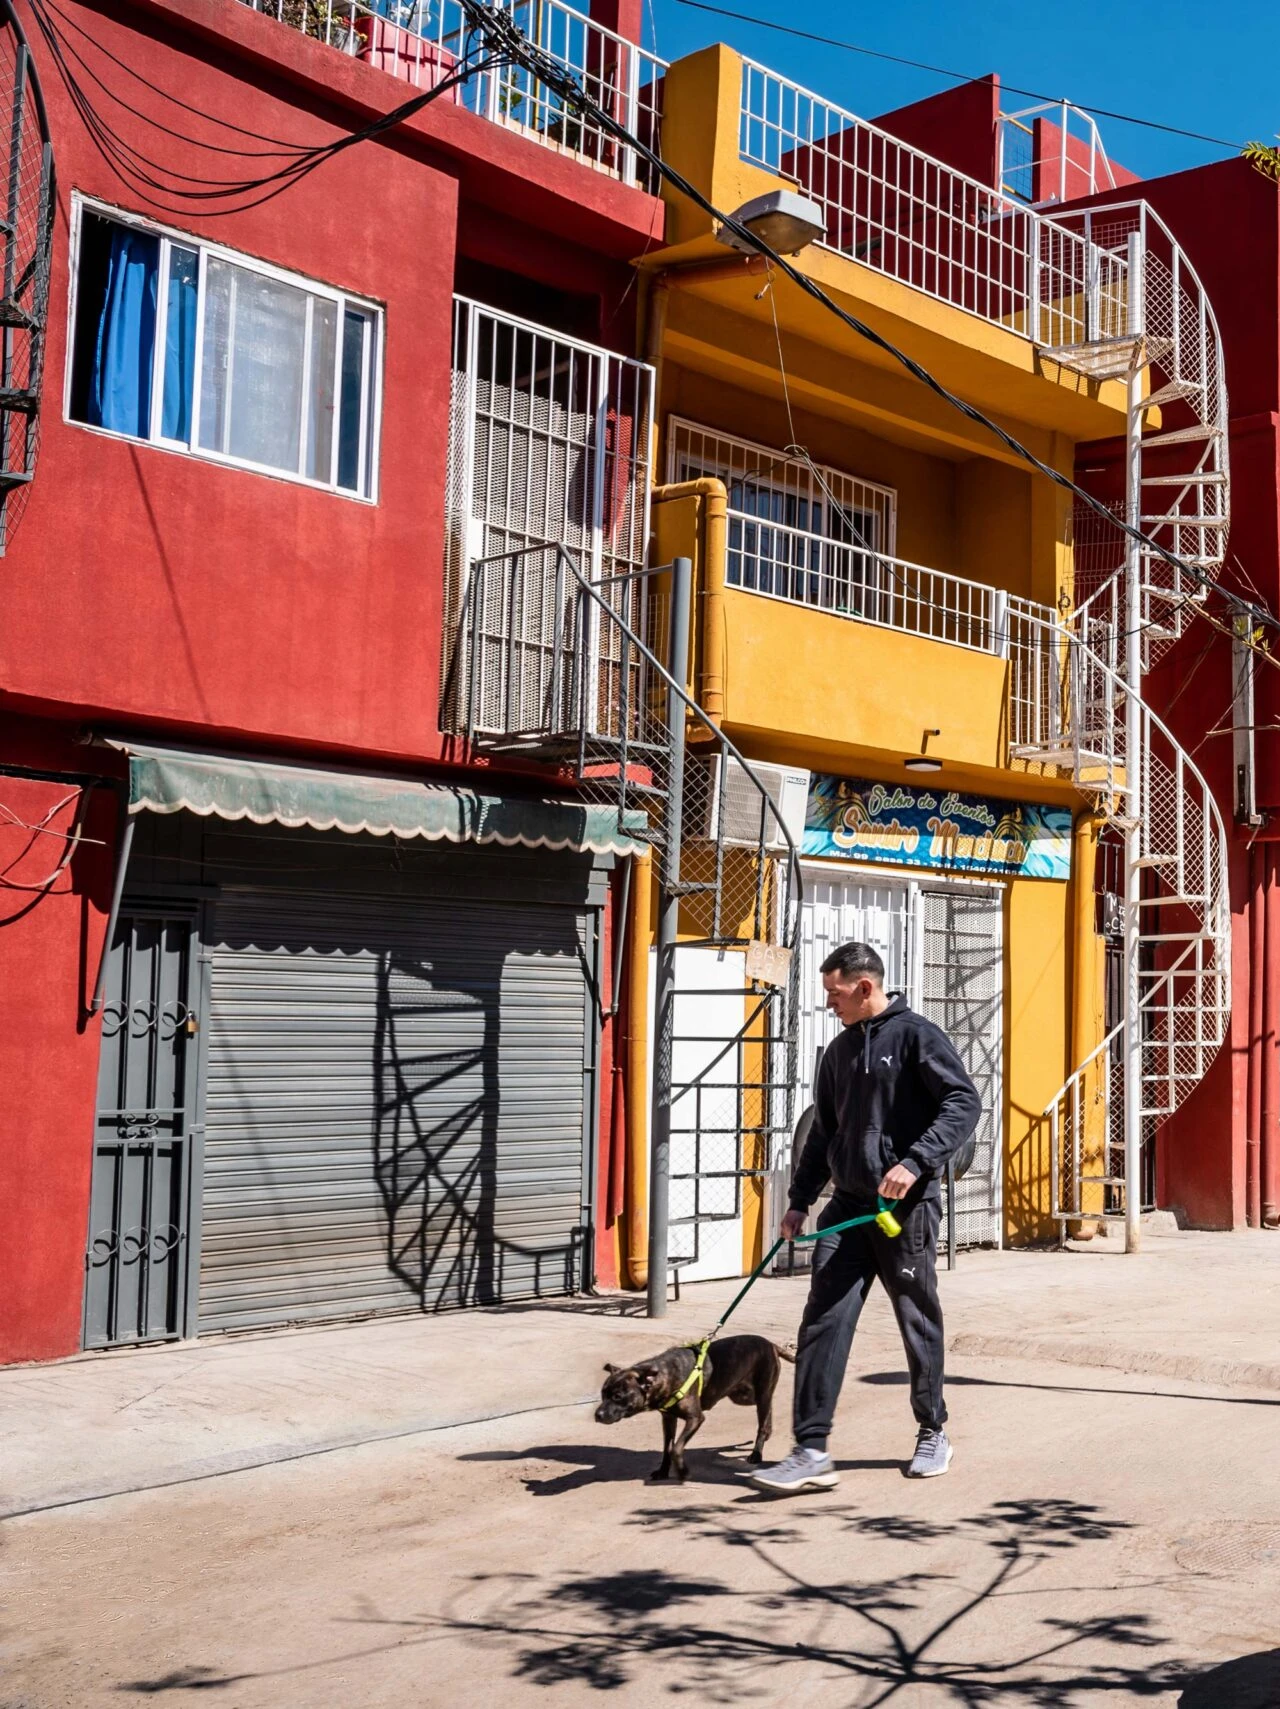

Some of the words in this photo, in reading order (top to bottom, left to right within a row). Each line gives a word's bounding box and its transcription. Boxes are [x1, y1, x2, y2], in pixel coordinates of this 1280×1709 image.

[831, 806, 920, 854] Sandro
[917, 792, 937, 810] de
[939, 791, 996, 827] Eventos
